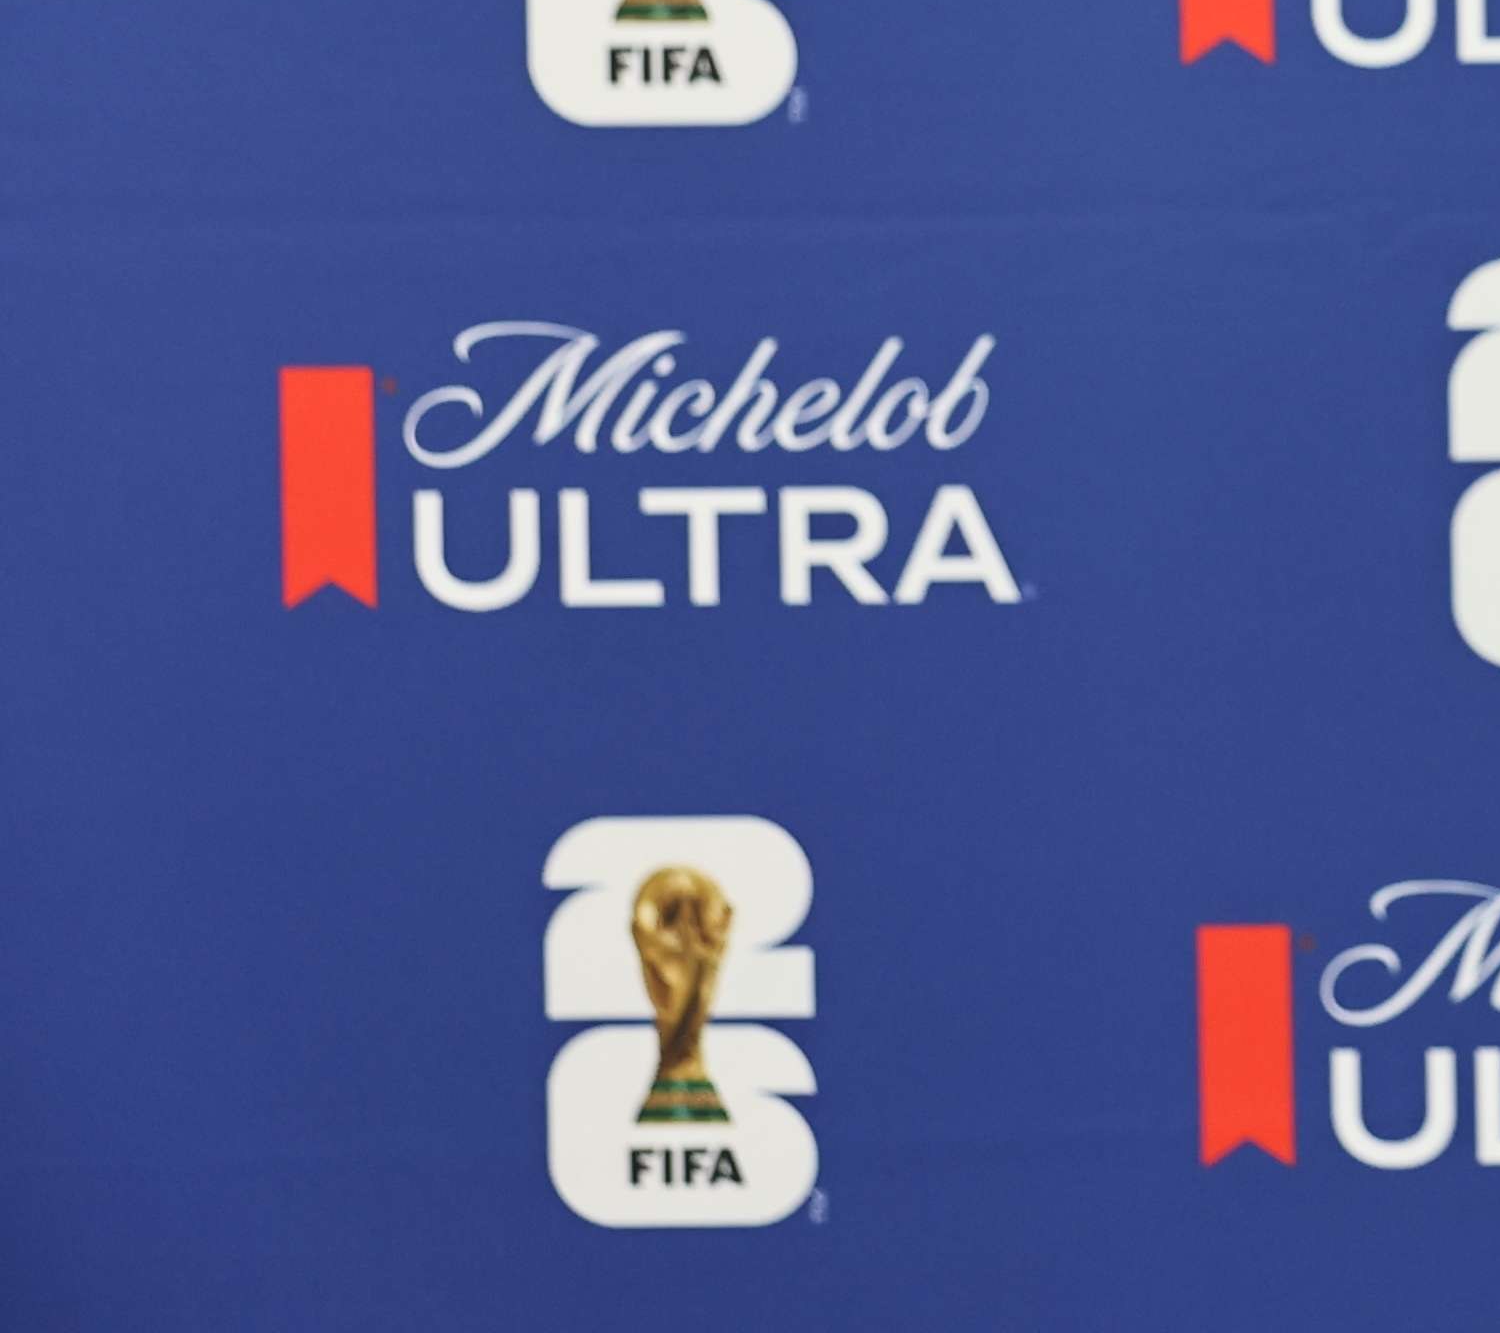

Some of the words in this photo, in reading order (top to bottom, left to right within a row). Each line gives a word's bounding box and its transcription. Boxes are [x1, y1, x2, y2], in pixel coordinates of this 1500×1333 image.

[609, 46, 722, 85] FIFA
[405, 323, 993, 467] Michelob
[414, 486, 1020, 611] ULTRA
[629, 1147, 744, 1187] FIFA
